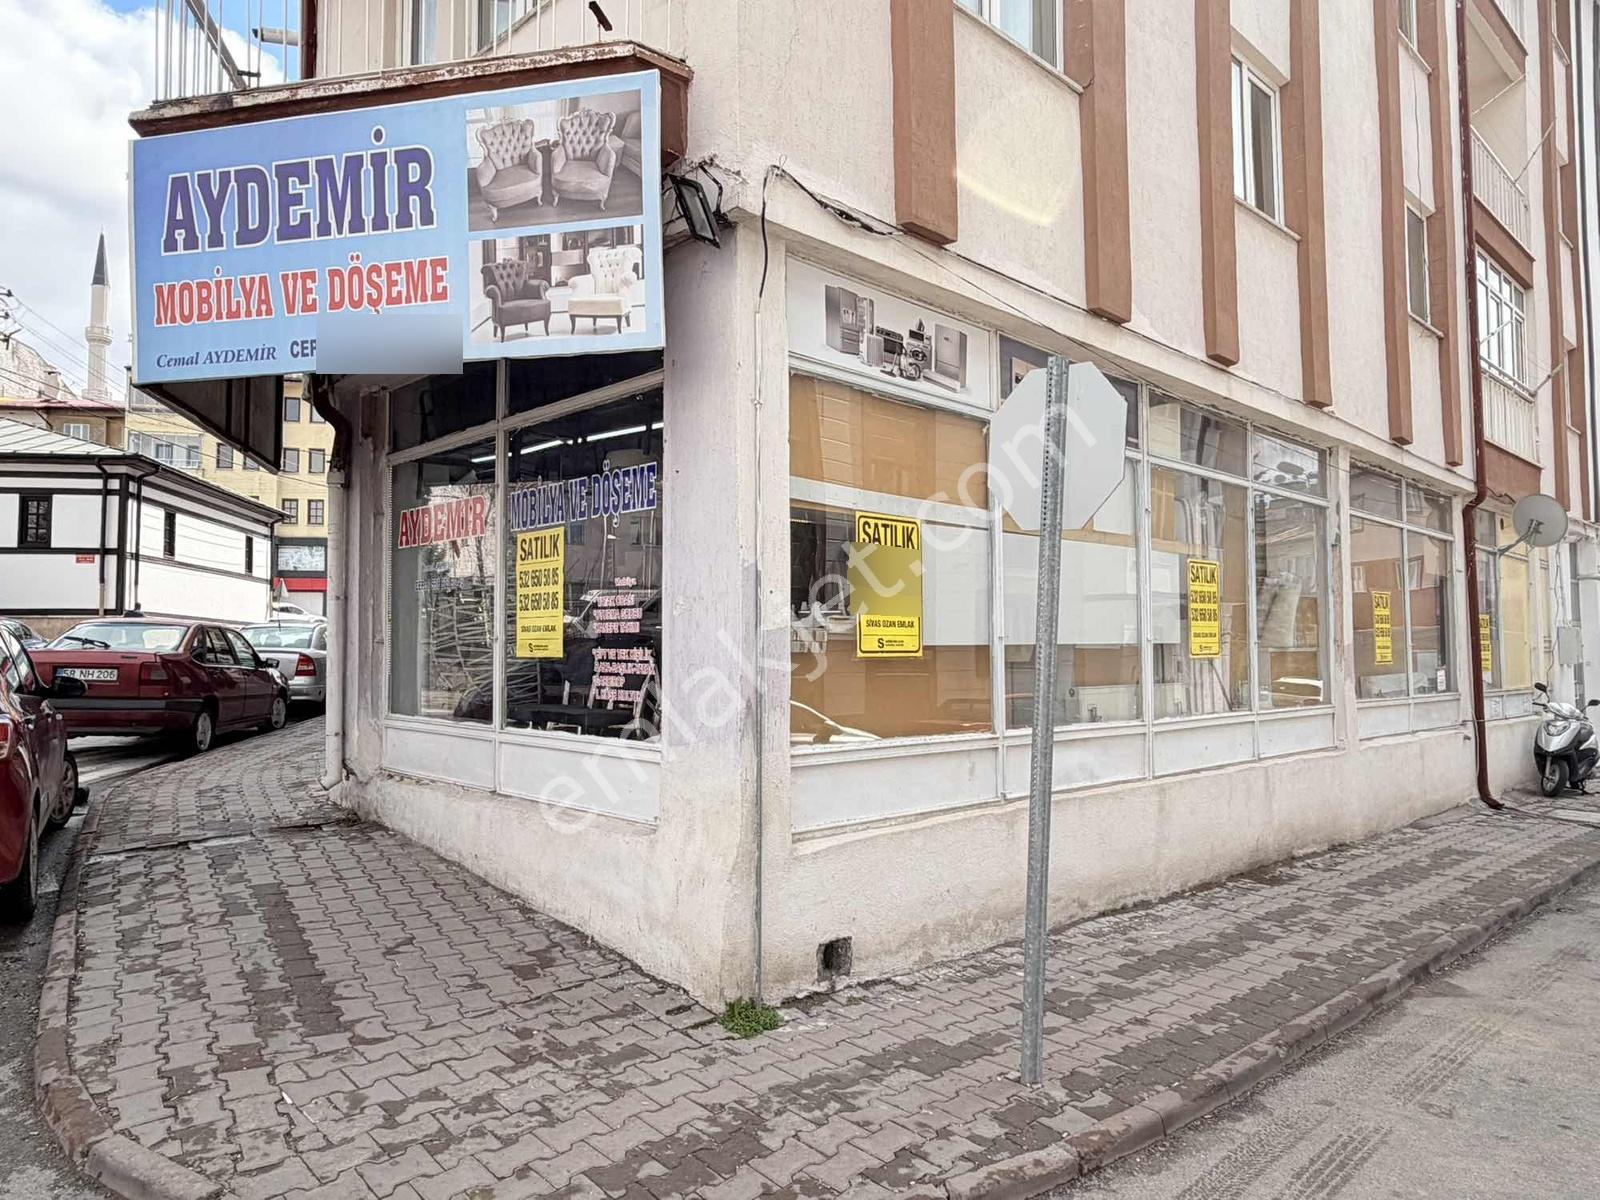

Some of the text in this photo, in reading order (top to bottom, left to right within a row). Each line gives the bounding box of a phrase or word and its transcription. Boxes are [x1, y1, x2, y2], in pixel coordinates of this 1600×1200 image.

[161, 125, 438, 257] AYDEMİR
[154, 252, 449, 327] MOBİLYA VE DÖŞEME
[156, 352, 200, 368] Cemal
[202, 344, 278, 365] AYDEMİR
[510, 460, 657, 531] MOBİLYA VE DÖŞEME
[519, 533, 561, 562] SATILIK
[862, 520, 915, 550] SATILIK
[1190, 565, 1217, 584] SATILIK
[866, 618, 915, 629] SİVAS OZAN EMLAK
[79, 669, 95, 679] NH
[96, 670, 115, 679] 206
